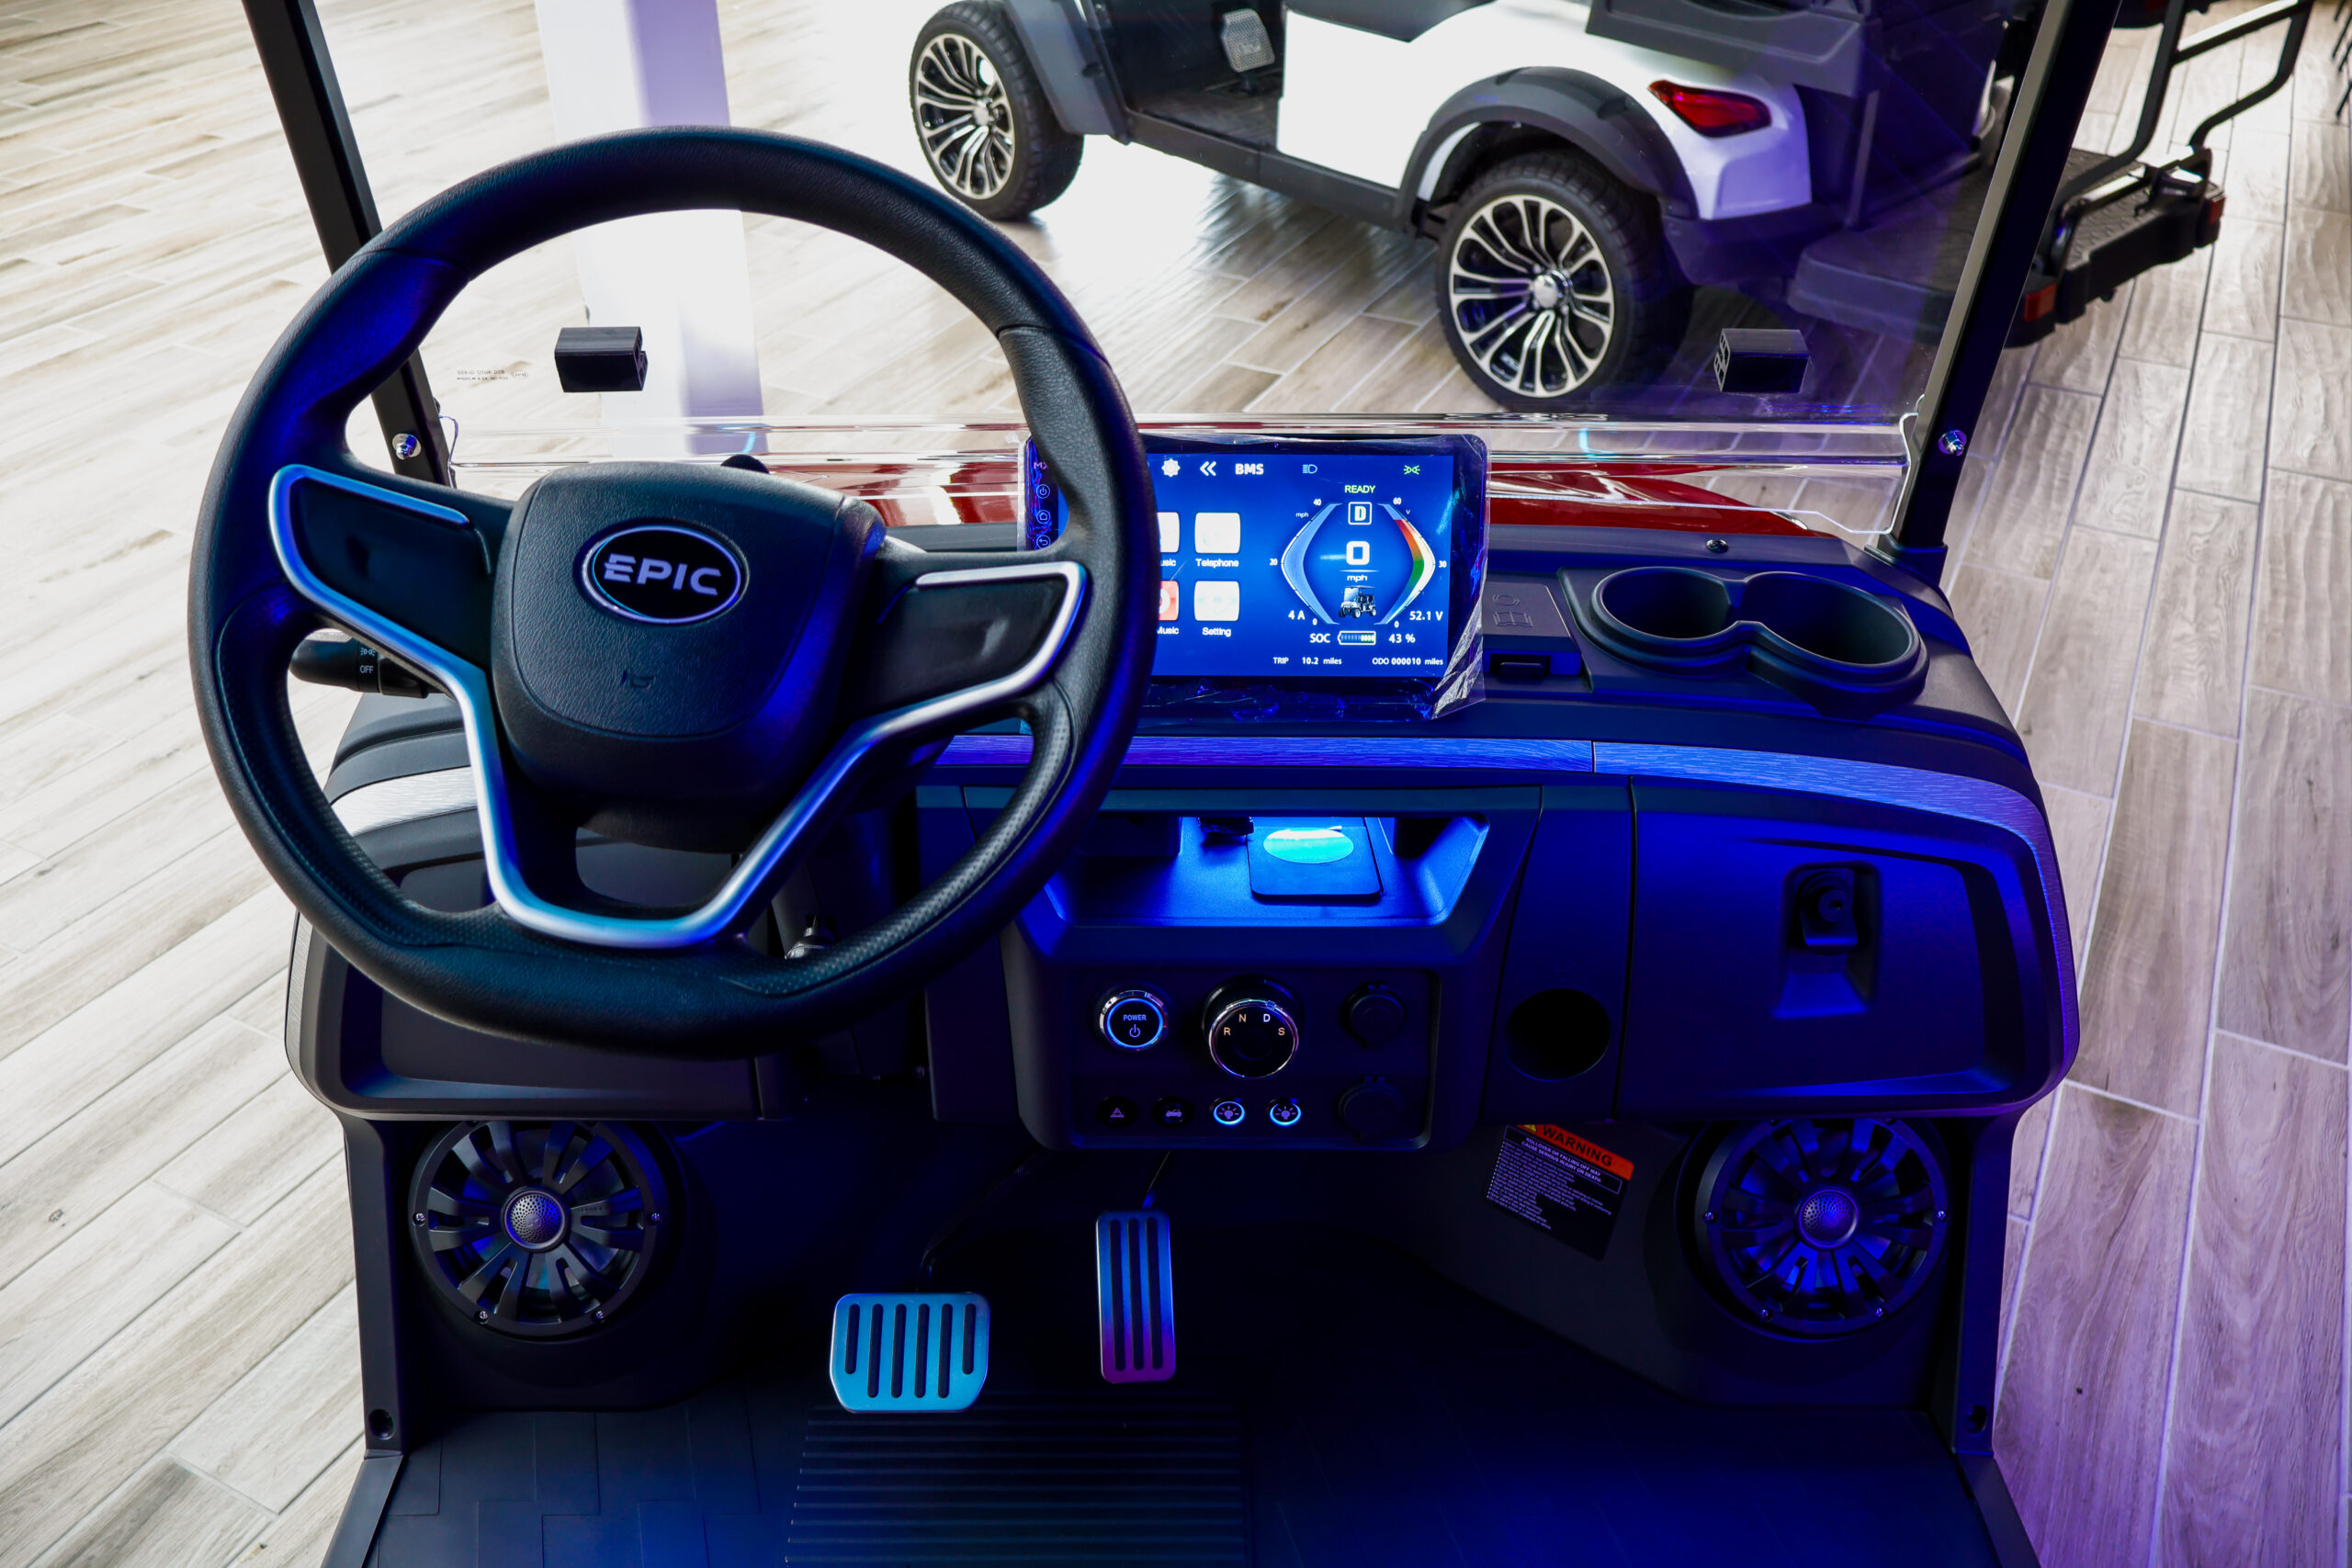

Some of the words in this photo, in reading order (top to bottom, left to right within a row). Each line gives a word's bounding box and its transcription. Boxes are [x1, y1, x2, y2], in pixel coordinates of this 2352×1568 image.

[1235, 463, 1264, 475] BMS
[1344, 485, 1376, 493] READY
[1393, 497, 1402, 505] 60
[1354, 505, 1367, 522] D
[1159, 558, 1177, 567] usic
[1195, 558, 1239, 569] Telephone
[1439, 560, 1447, 569] 30
[603, 553, 721, 596] EPIC
[1347, 574, 1368, 583] mph
[1288, 610, 1295, 620] 4
[1297, 610, 1306, 620] A
[1409, 611, 1431, 621] 52.1
[1435, 611, 1443, 621] V
[1202, 627, 1232, 637] Setting
[1309, 633, 1331, 644] SOC
[1388, 634, 1402, 644] 43
[1405, 634, 1416, 644] %
[1302, 657, 1319, 665] 10.2
[1323, 657, 1342, 665] miles
[1424, 658, 1443, 666] miles
[359, 665, 374, 674] OFF
[1123, 1013, 1148, 1021] POWER
[1223, 1027, 1231, 1036] R
[1238, 1013, 1247, 1023] N
[1262, 1013, 1272, 1023] D
[1277, 1027, 1286, 1036] S
[1543, 1125, 1613, 1167] WARNING
[1521, 1141, 1538, 1152] CAUSE
[1538, 1148, 1559, 1163] SERIOUS
[1559, 1157, 1577, 1170] INJURY
[1525, 1136, 1552, 1154] ROLLOVER
[1559, 1152, 1580, 1168] FALLING
[1579, 1162, 1590, 1172] OFF
[1590, 1167, 1601, 1177] MAY
